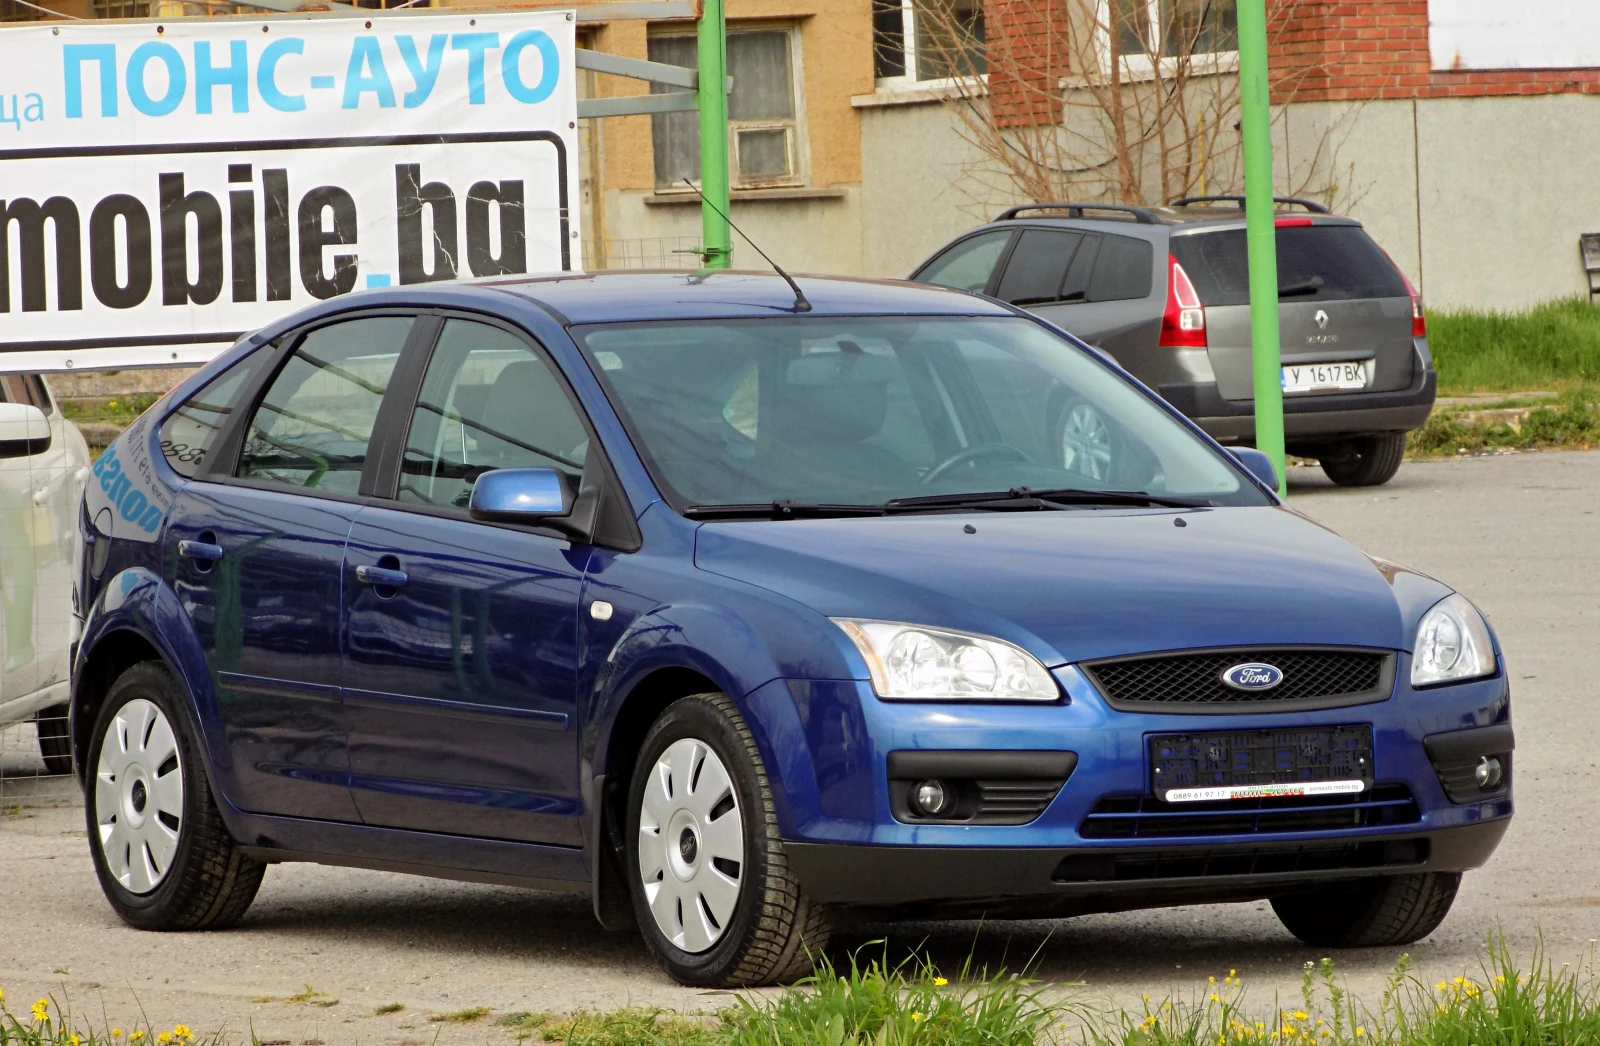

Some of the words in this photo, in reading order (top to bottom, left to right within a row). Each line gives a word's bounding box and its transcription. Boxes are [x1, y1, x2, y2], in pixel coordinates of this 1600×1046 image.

[63, 29, 560, 119] ПОНС-АУТО
[1310, 366, 1341, 382] 1617
[1239, 668, 1271, 683] Ford
[1173, 792, 1192, 800] 0889
